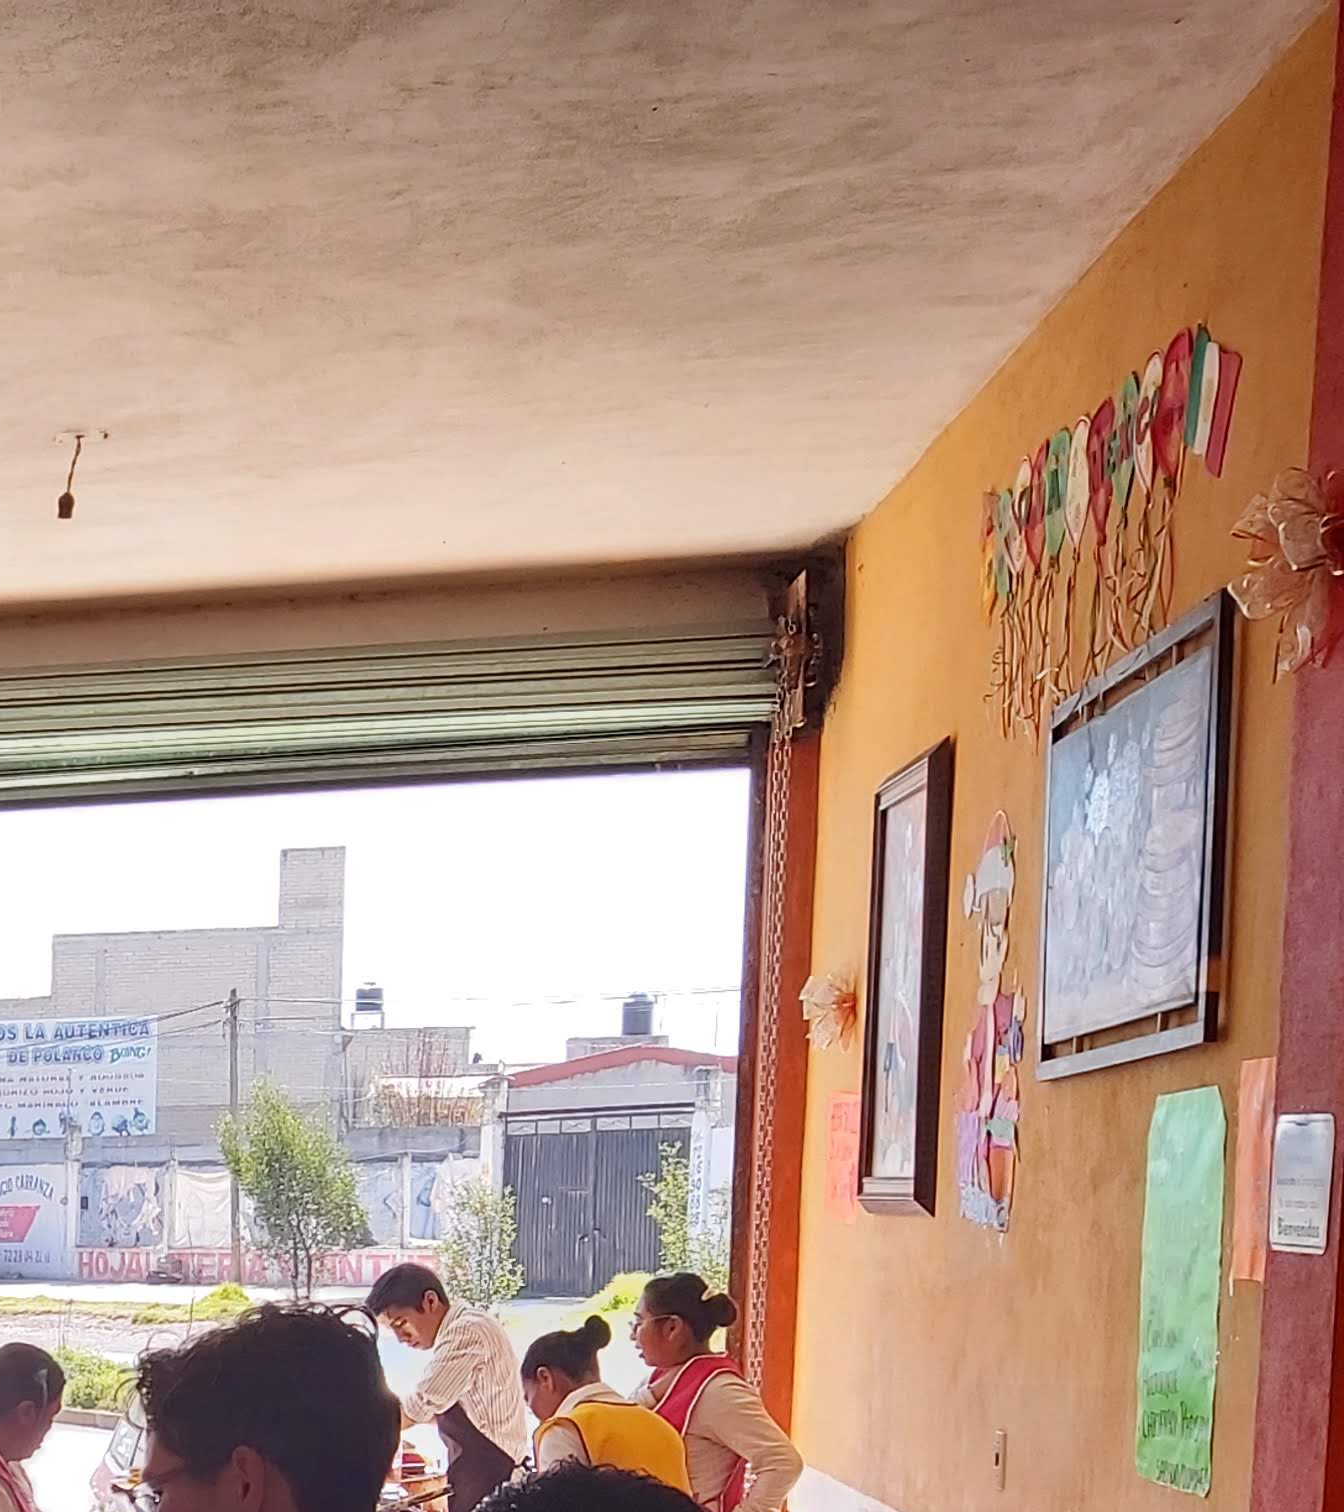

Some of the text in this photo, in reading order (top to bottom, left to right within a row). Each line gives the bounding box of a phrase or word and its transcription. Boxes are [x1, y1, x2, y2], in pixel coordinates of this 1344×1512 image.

[24, 1023, 46, 1040] LA
[53, 1021, 150, 1040] AUTENTICA
[7, 1047, 28, 1064] DE
[33, 1046, 105, 1064] POLANCO
[78, 1250, 268, 1282] HOJALTERIA
